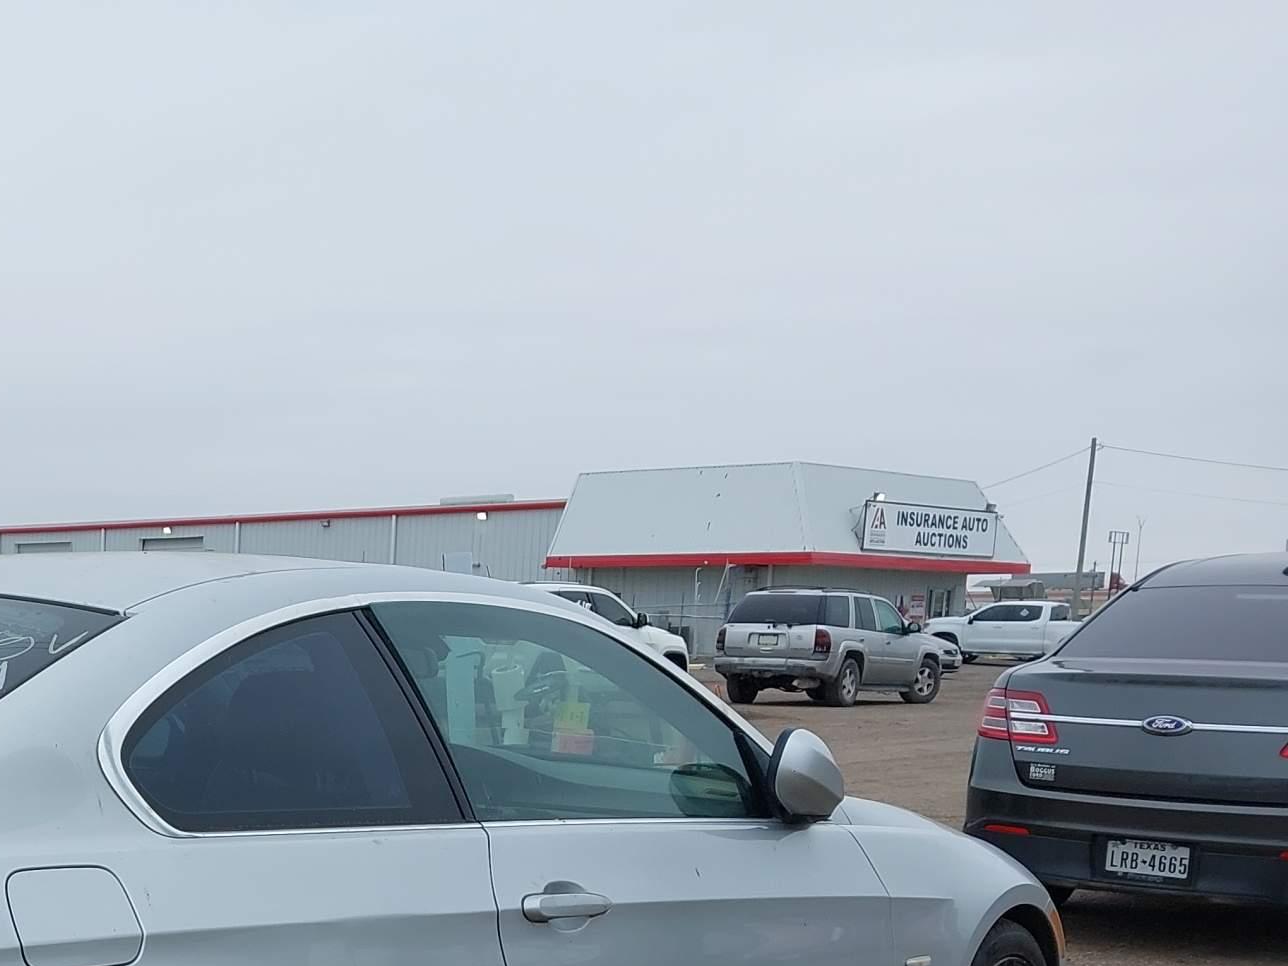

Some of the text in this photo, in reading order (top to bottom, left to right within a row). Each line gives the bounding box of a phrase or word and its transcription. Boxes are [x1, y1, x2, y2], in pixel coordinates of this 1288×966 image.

[896, 510, 989, 532] INSURANCE AUTO
[915, 531, 968, 549] AUCTIONS
[1152, 718, 1178, 730] Ford
[1133, 842, 1166, 852] TEXAS
